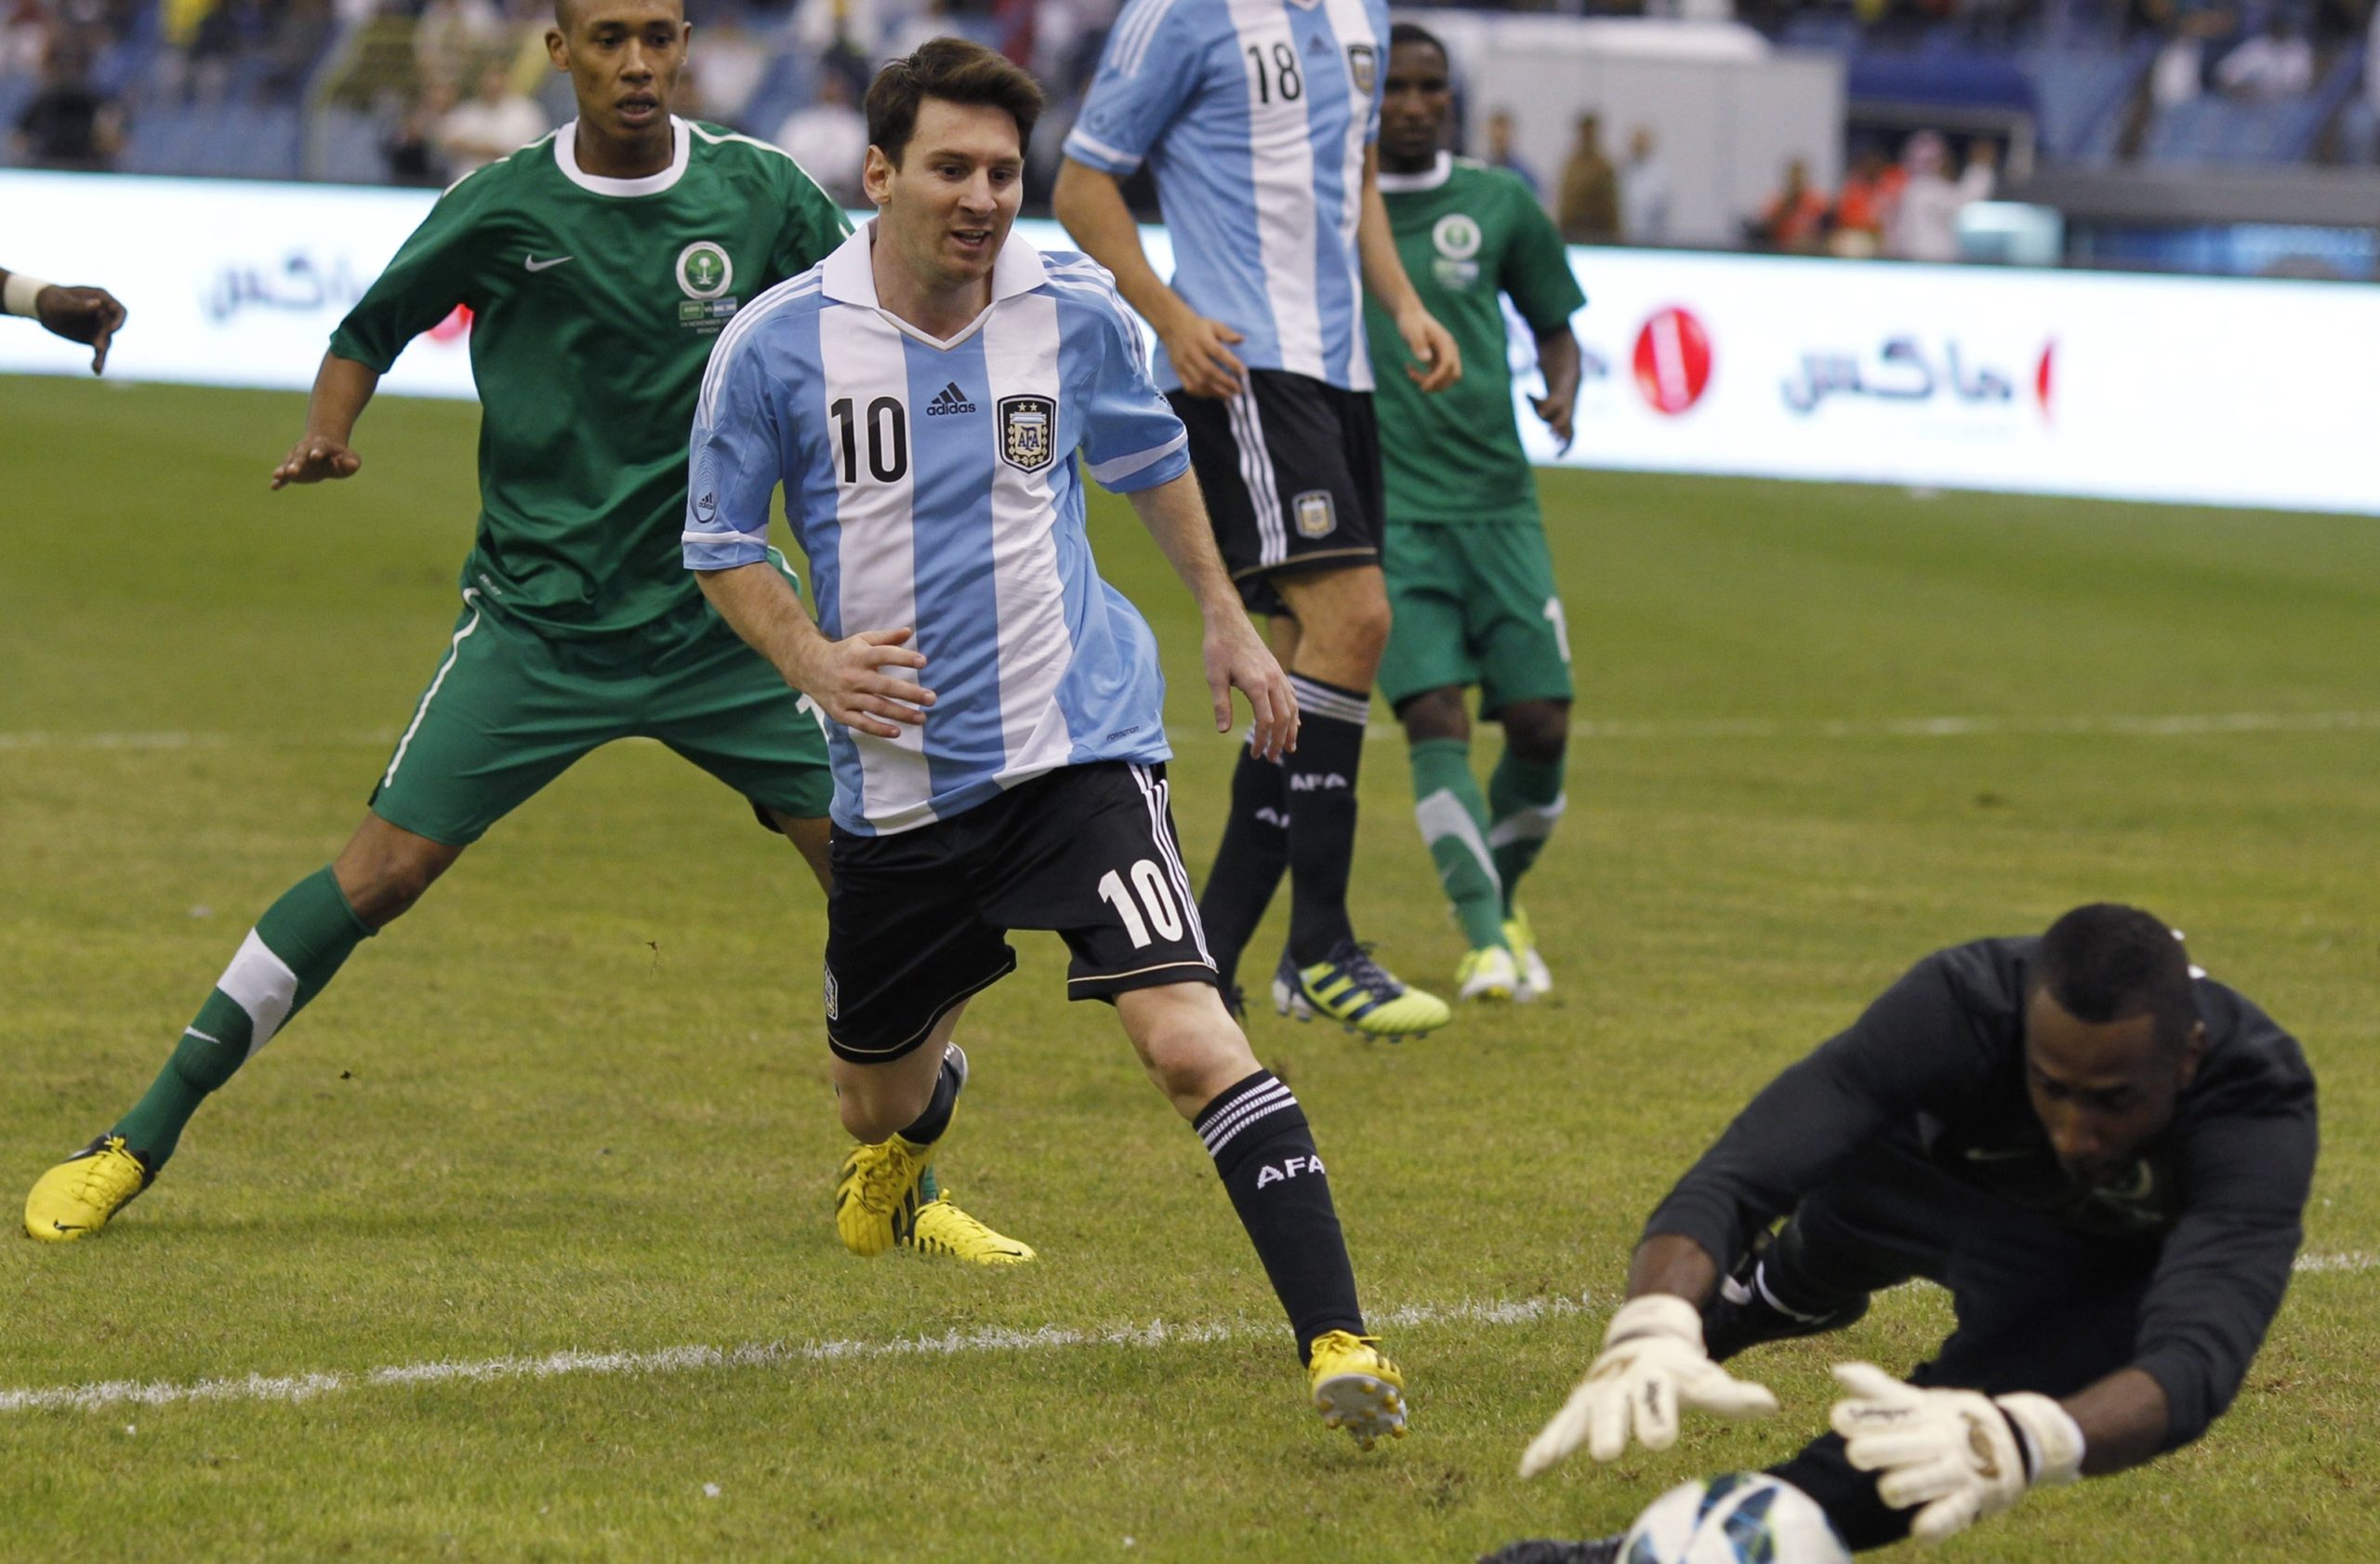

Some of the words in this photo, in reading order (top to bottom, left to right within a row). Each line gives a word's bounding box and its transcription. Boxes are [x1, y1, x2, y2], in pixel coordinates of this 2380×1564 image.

[1249, 44, 1301, 104] 18
[1779, 337, 2015, 416] ماكس
[926, 402, 976, 417] adidas
[1018, 425, 1040, 453] AFA
[830, 396, 908, 484] 10
[1097, 858, 1183, 949] 10
[1257, 1154, 1326, 1190] AFA
